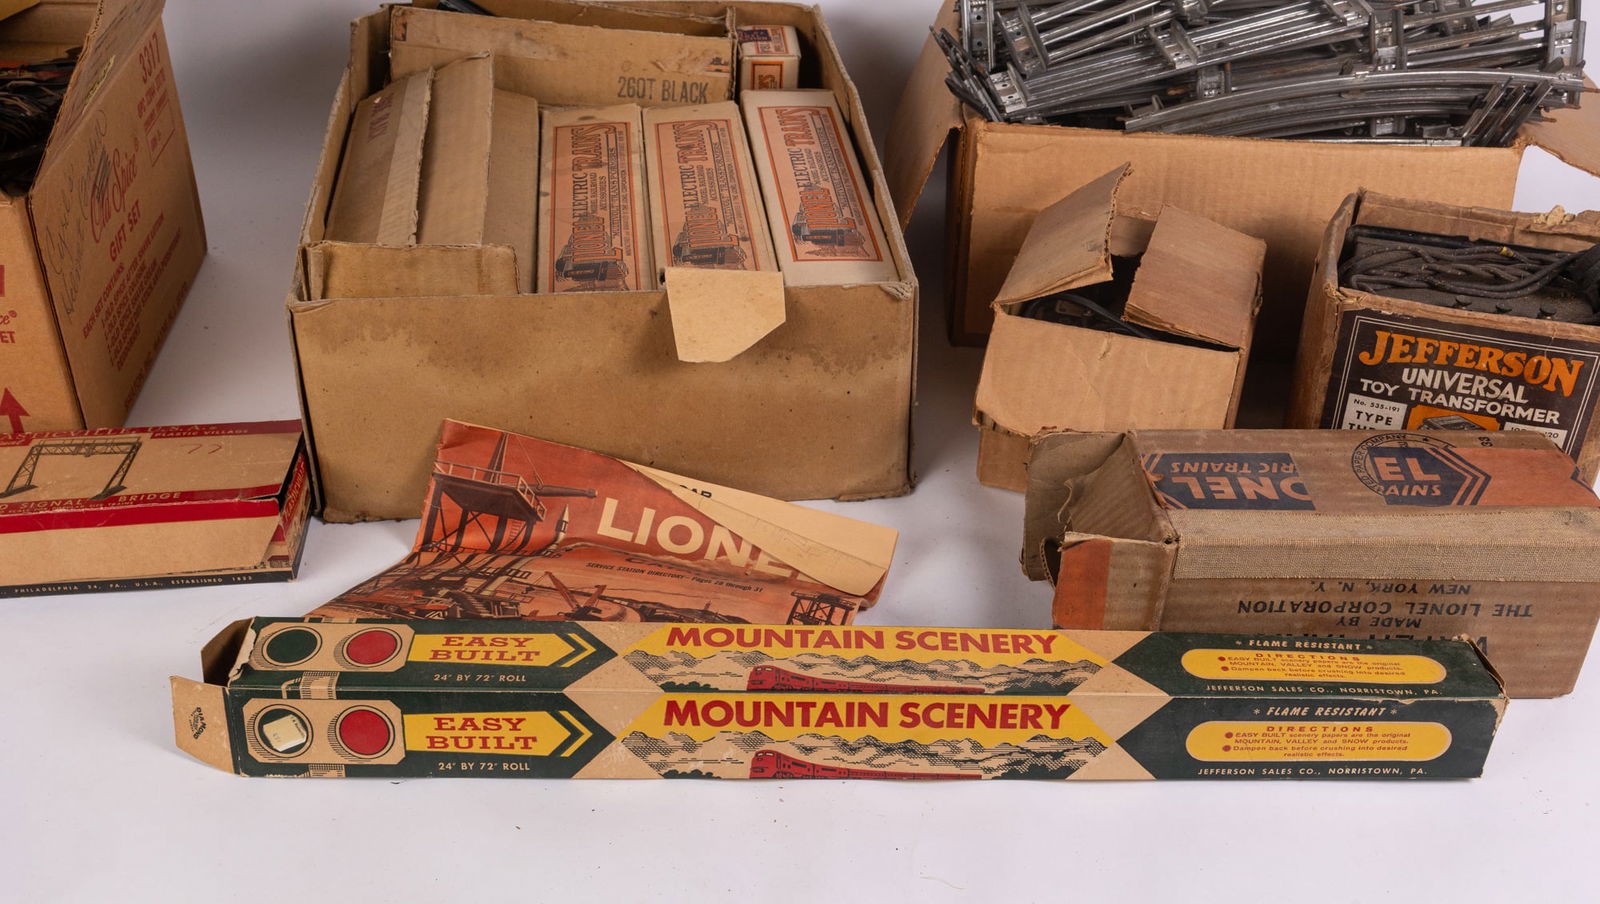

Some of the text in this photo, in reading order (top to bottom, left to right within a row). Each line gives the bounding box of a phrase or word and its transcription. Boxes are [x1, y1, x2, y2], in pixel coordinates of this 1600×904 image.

[138, 30, 161, 86] 3317
[661, 79, 709, 103] BLACK
[775, 108, 828, 146] TRAINS
[672, 122, 722, 163] TRAINS
[786, 147, 812, 187] ELECTRIC
[570, 124, 623, 261] LIONEL ELECTRIC TRAINS
[679, 164, 700, 208] ELECTRIC
[795, 186, 856, 228] LIONEL
[108, 198, 140, 264] GIFT SET
[684, 206, 739, 247] LIONEL
[1358, 330, 1585, 397] JEFFERSON
[1401, 368, 1529, 404] UNIVERSAL
[1353, 398, 1400, 412] No. 535-191
[1360, 378, 1560, 425] TOY TRANSFORMER
[1355, 410, 1393, 426] TYPE
[1170, 462, 1252, 474] TRAINS
[1373, 456, 1441, 481] EL
[21, 499, 83, 509] SIGNAL
[118, 492, 183, 502] BRIDGE
[586, 562, 615, 570] SERVICE
[616, 565, 645, 574] STATION
[691, 576, 711, 584] Pages
[726, 582, 752, 591] through
[1310, 580, 1471, 595] NEW YORK, N. Y.
[1237, 599, 1534, 618] THE LIONEL CORPORATION
[1336, 616, 1421, 629] MADE BY
[441, 636, 534, 648] EASY
[666, 626, 1058, 655] MOUNTAIN SCENERY
[1249, 639, 1361, 650] FLAME RESISTANT
[428, 649, 540, 662] BUILT
[1255, 653, 1361, 661] DIRECTIONS
[456, 673, 470, 682] BY
[499, 673, 527, 682] ROLL
[1205, 684, 1264, 692] JEFFERSON
[1271, 685, 1304, 693] SALES
[1340, 687, 1417, 696] NORRISTOWN,
[663, 700, 1071, 730] MOUNTAIN SCENERY
[1266, 706, 1386, 716] FLAME RESISTANT
[433, 717, 528, 732] EASY
[426, 735, 538, 751] BUILT
[461, 761, 475, 771] BY
[502, 761, 530, 771] ROLL
[1328, 767, 1403, 776] NORRISTOWN,
[1411, 767, 1428, 775] PA.
